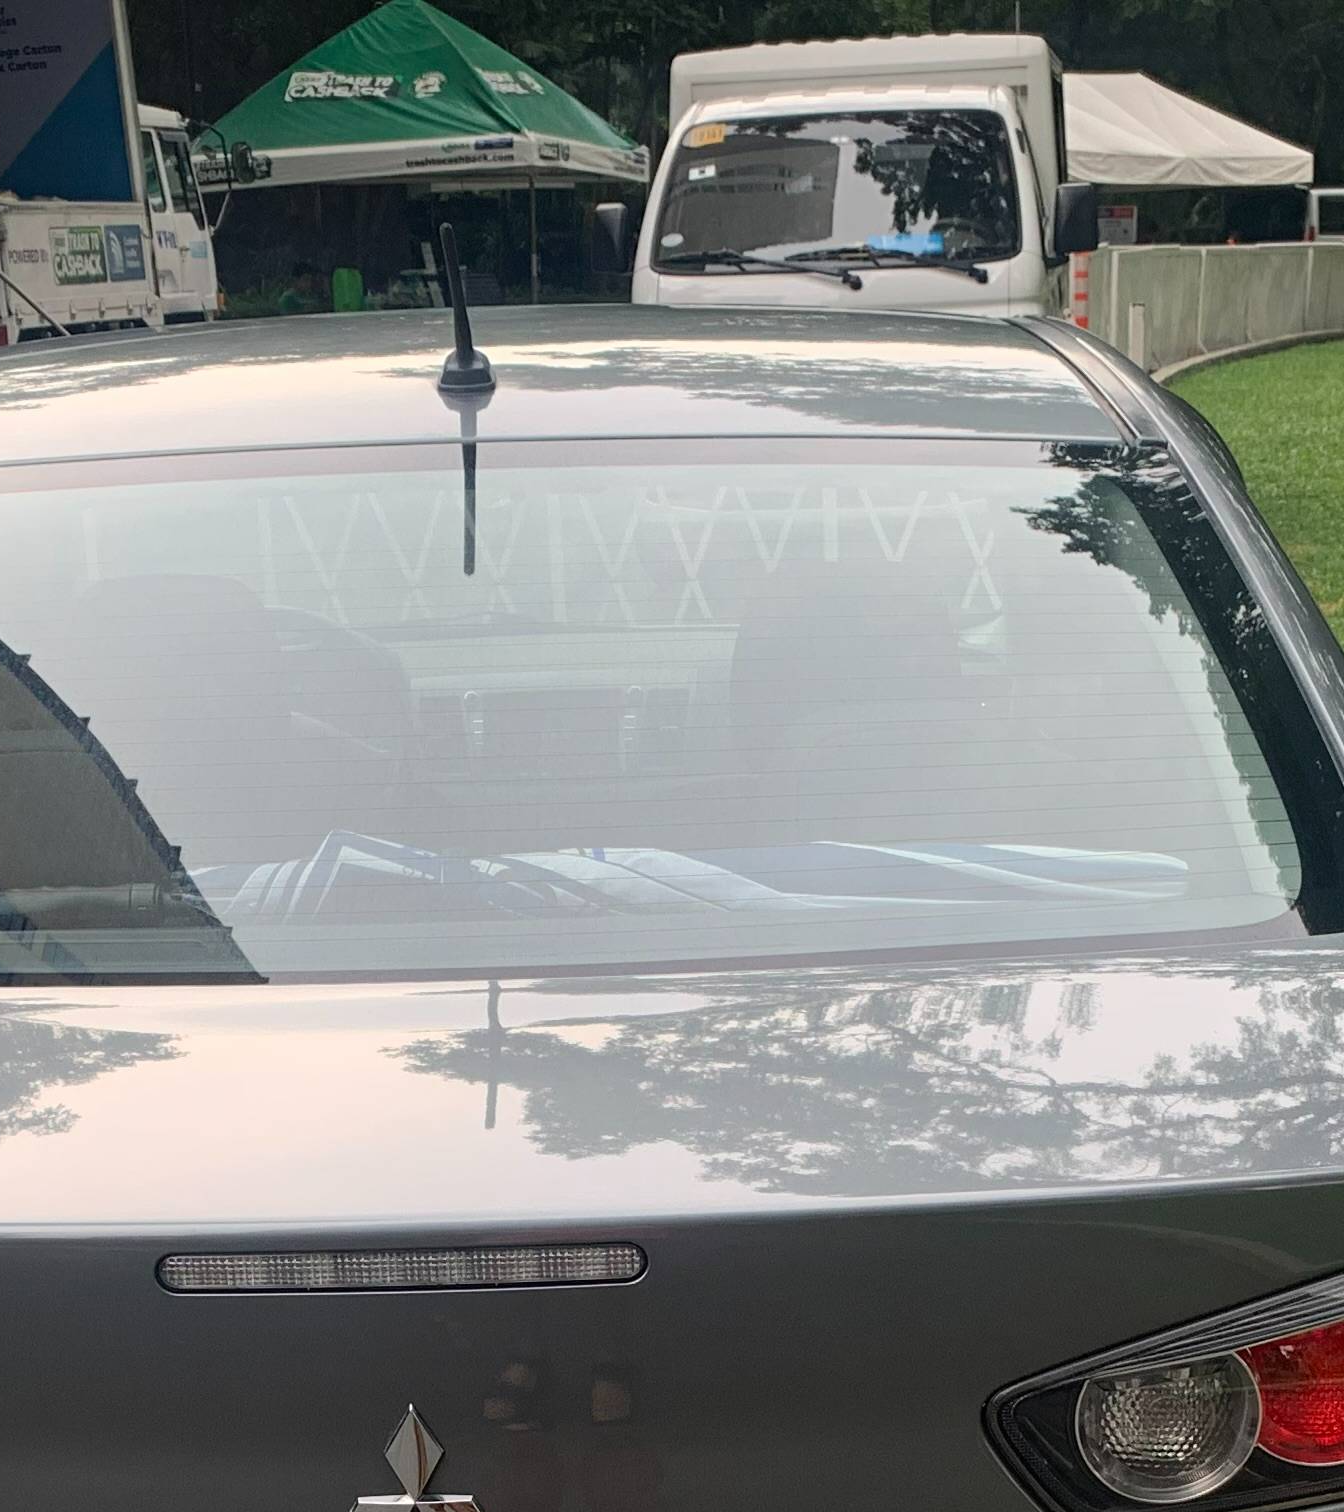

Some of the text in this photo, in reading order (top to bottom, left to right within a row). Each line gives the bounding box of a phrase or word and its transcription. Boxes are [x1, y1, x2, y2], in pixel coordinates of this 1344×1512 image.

[22, 44, 62, 56] Carton
[7, 61, 47, 73] Carton
[8, 248, 40, 264] POWERED
[54, 253, 104, 277] CASHBACK
